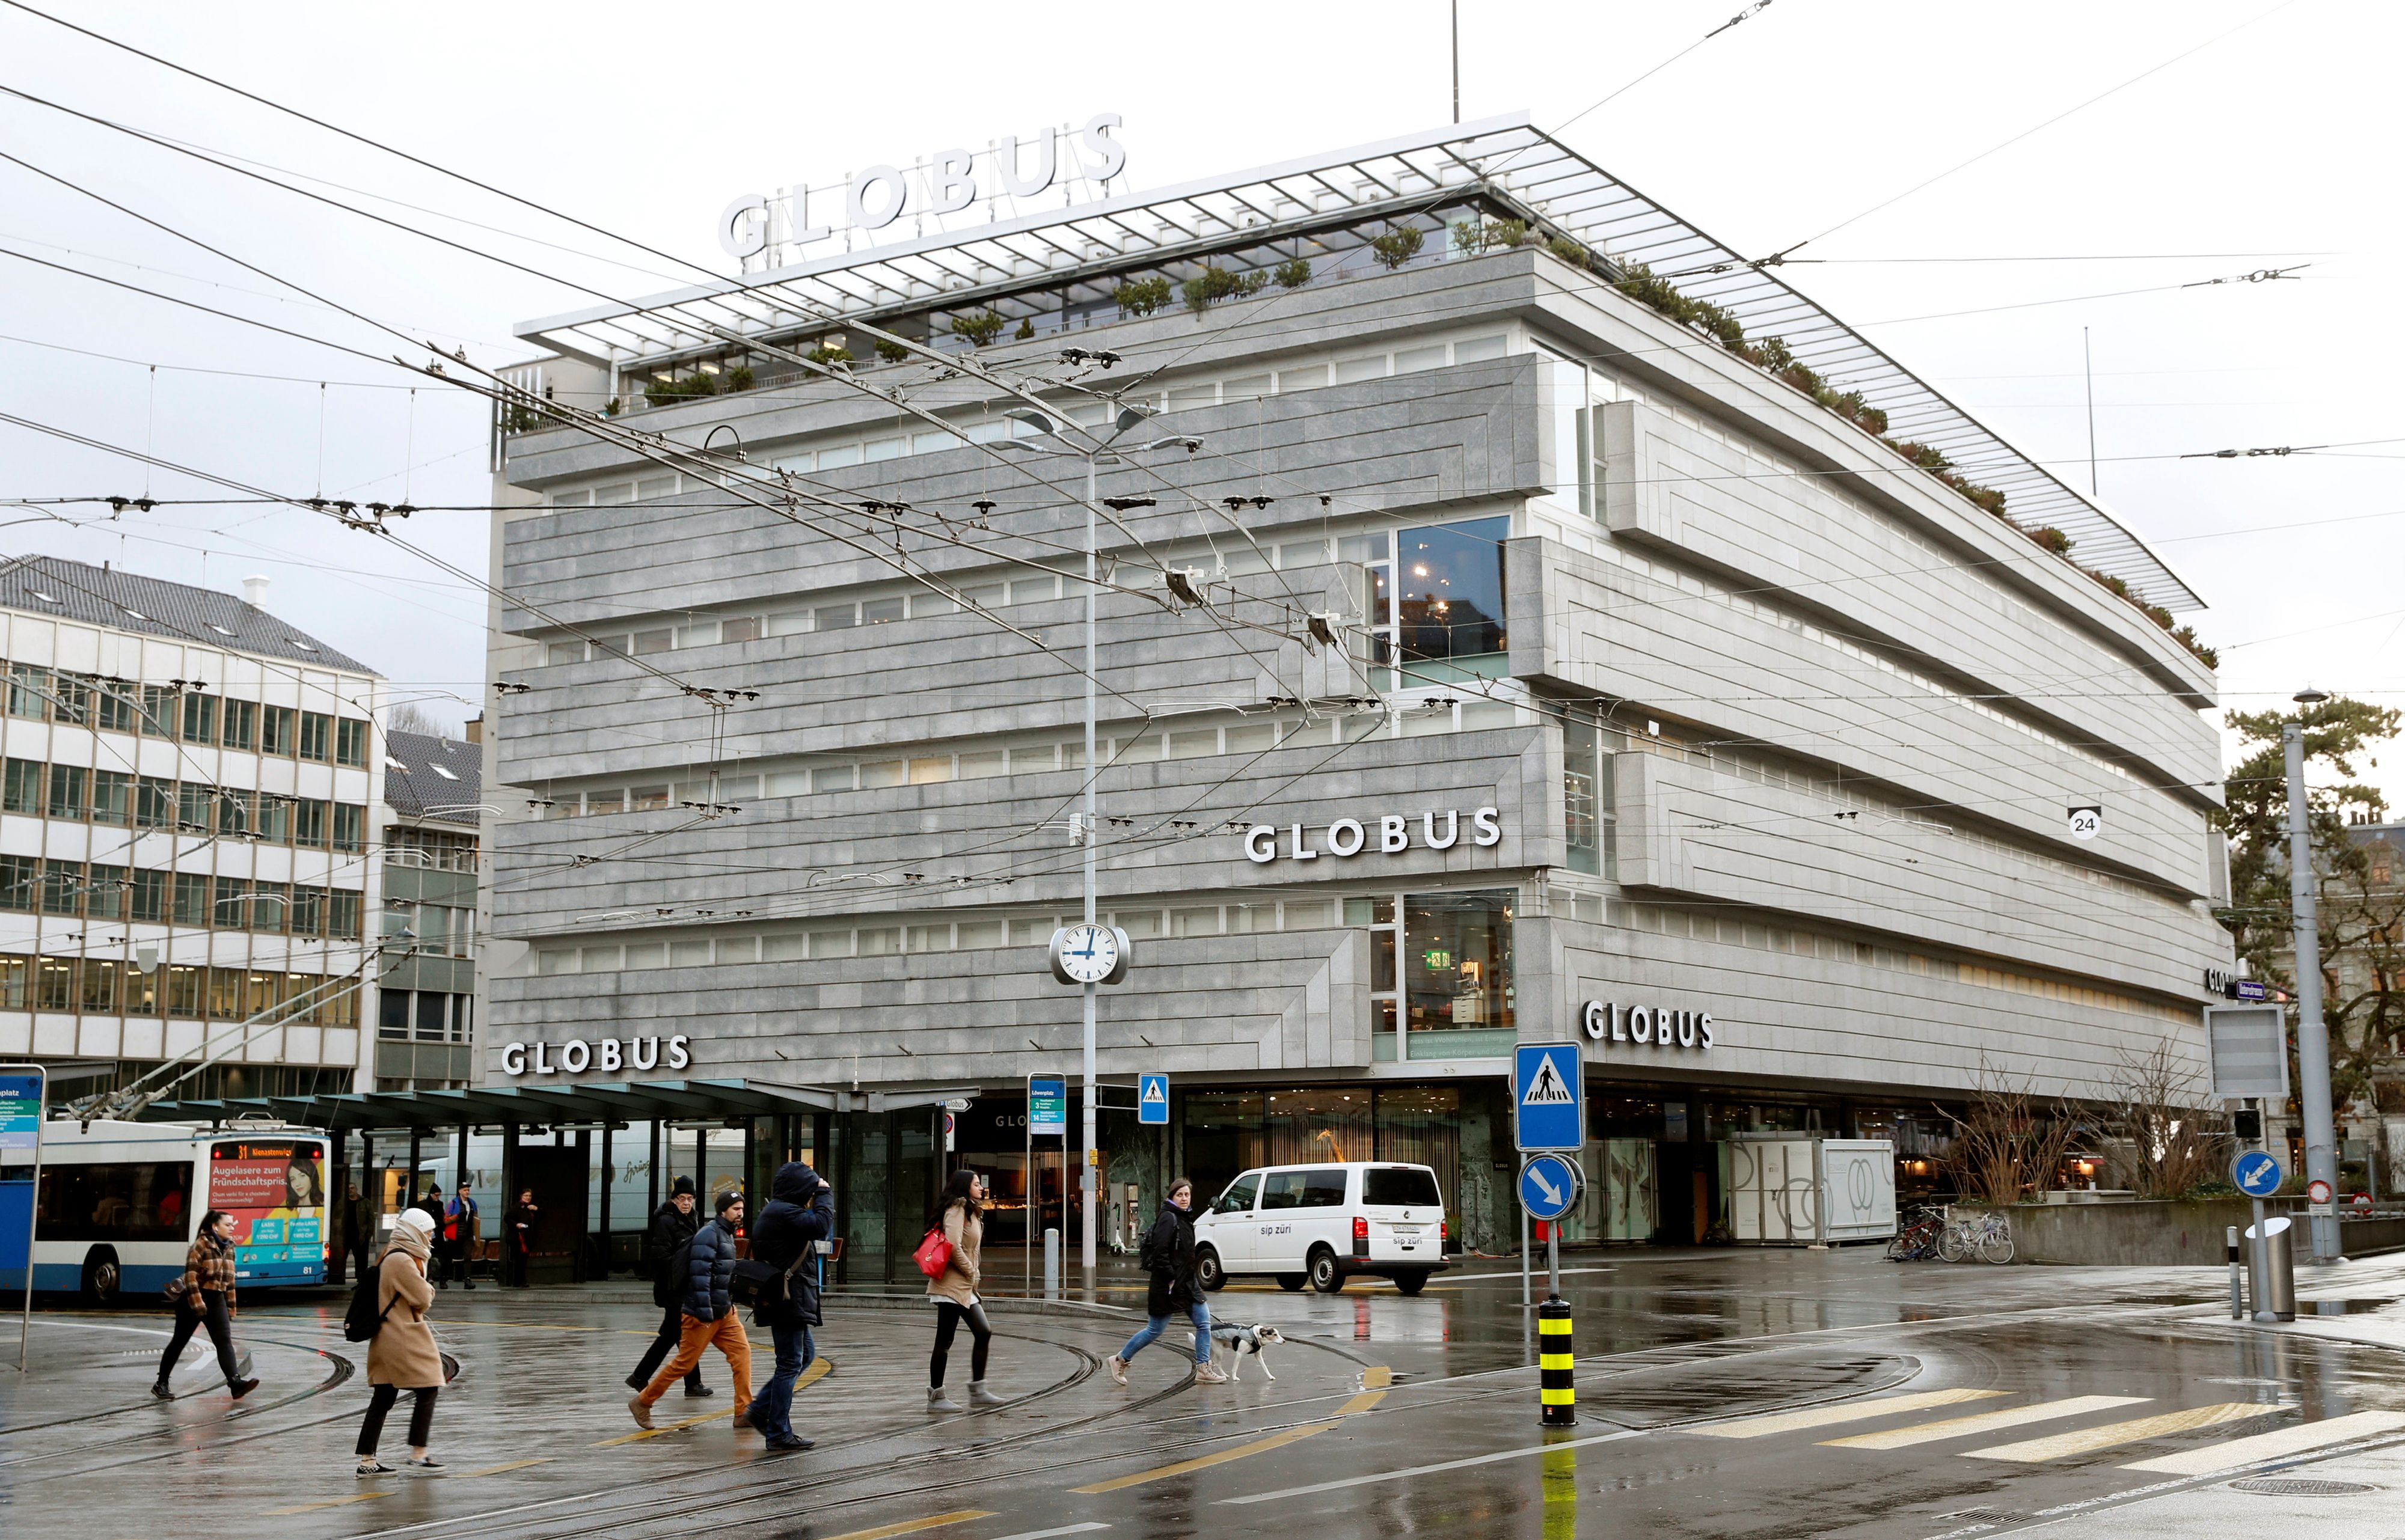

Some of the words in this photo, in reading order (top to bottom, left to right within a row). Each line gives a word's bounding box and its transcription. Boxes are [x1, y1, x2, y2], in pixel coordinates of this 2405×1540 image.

[718, 112, 1126, 258] GLOBUS
[2075, 817, 2095, 831] 24
[1244, 807, 1501, 863] GLOBUS
[1581, 1000, 1714, 1050] GLOBUS
[501, 1034, 691, 1076] GLOBUS
[1411, 1050, 1436, 1059] Einklang
[946, 1099, 964, 1108] Globus
[996, 1116, 1027, 1126] GLO
[239, 1145, 247, 1160] 31
[213, 1166, 261, 1176] Augelasere
[623, 1160, 650, 1183] Sprüng
[213, 1177, 287, 1187] Fründschaftspriis.
[1261, 1225, 1273, 1236] sip
[1393, 1237, 1405, 1245] sip
